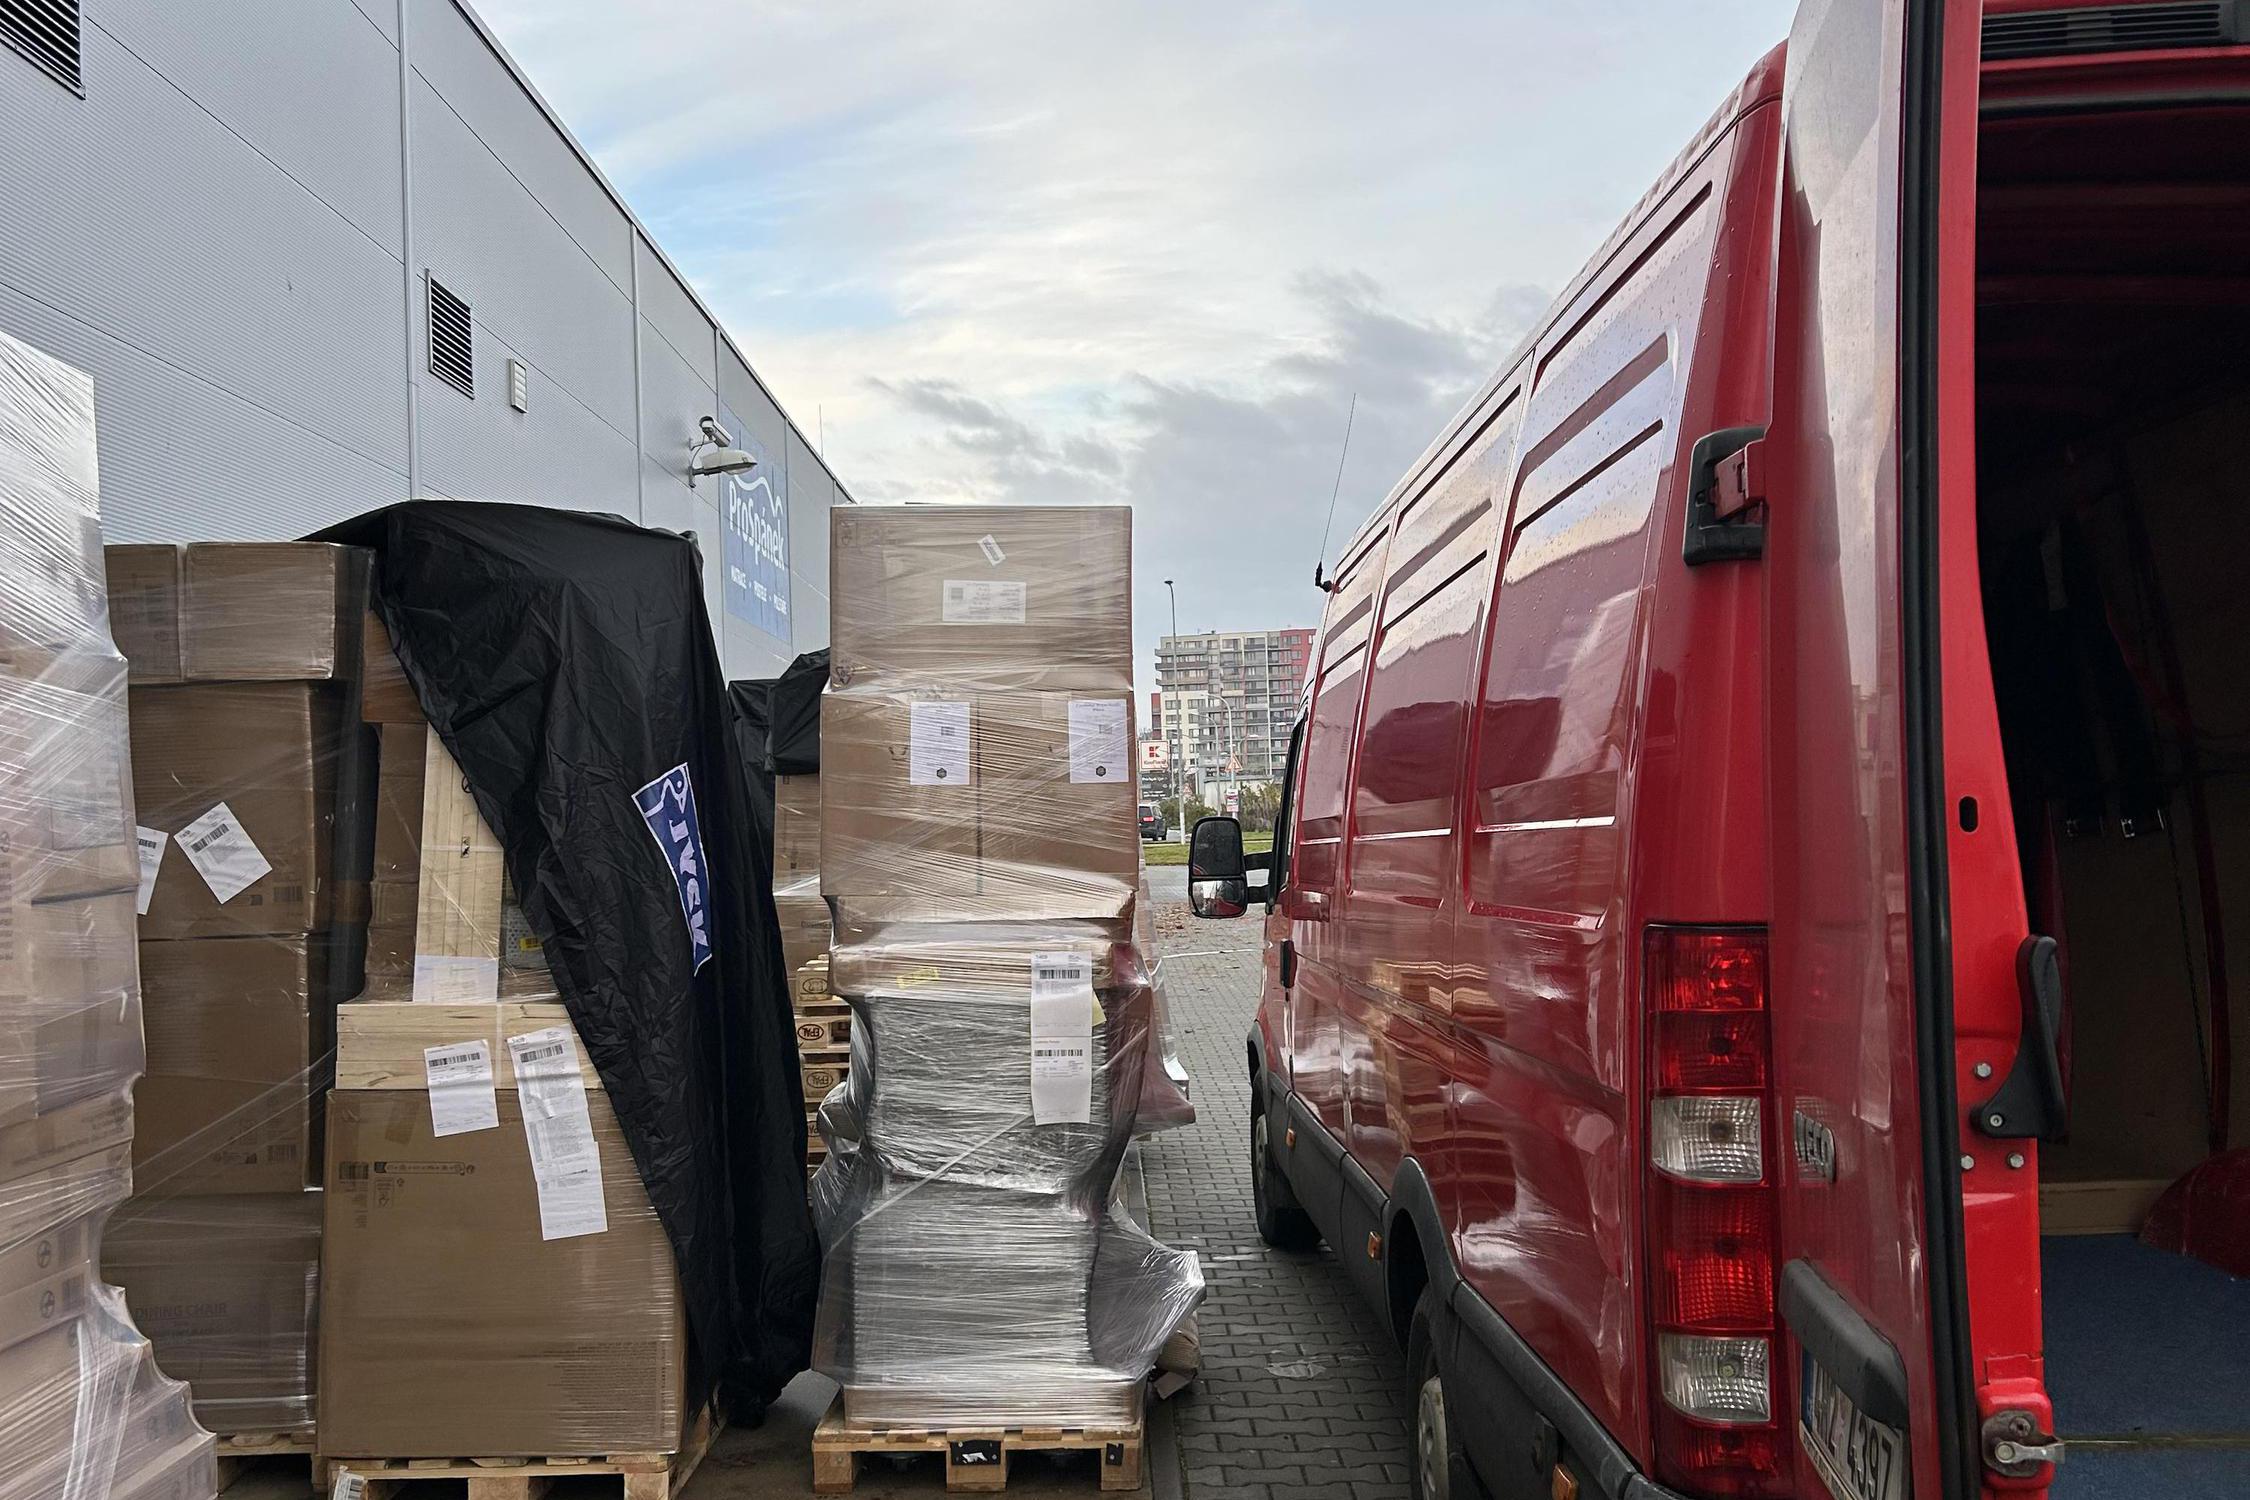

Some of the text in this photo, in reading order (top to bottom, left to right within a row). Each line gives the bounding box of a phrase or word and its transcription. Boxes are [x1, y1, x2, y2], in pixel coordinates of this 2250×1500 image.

[729, 480, 784, 570] ProSpánek
[669, 820, 709, 959] JYSK
[803, 1028, 820, 1037] EPAL
[1794, 1110, 1837, 1183] VECO
[187, 1303, 227, 1317] CHAIR
